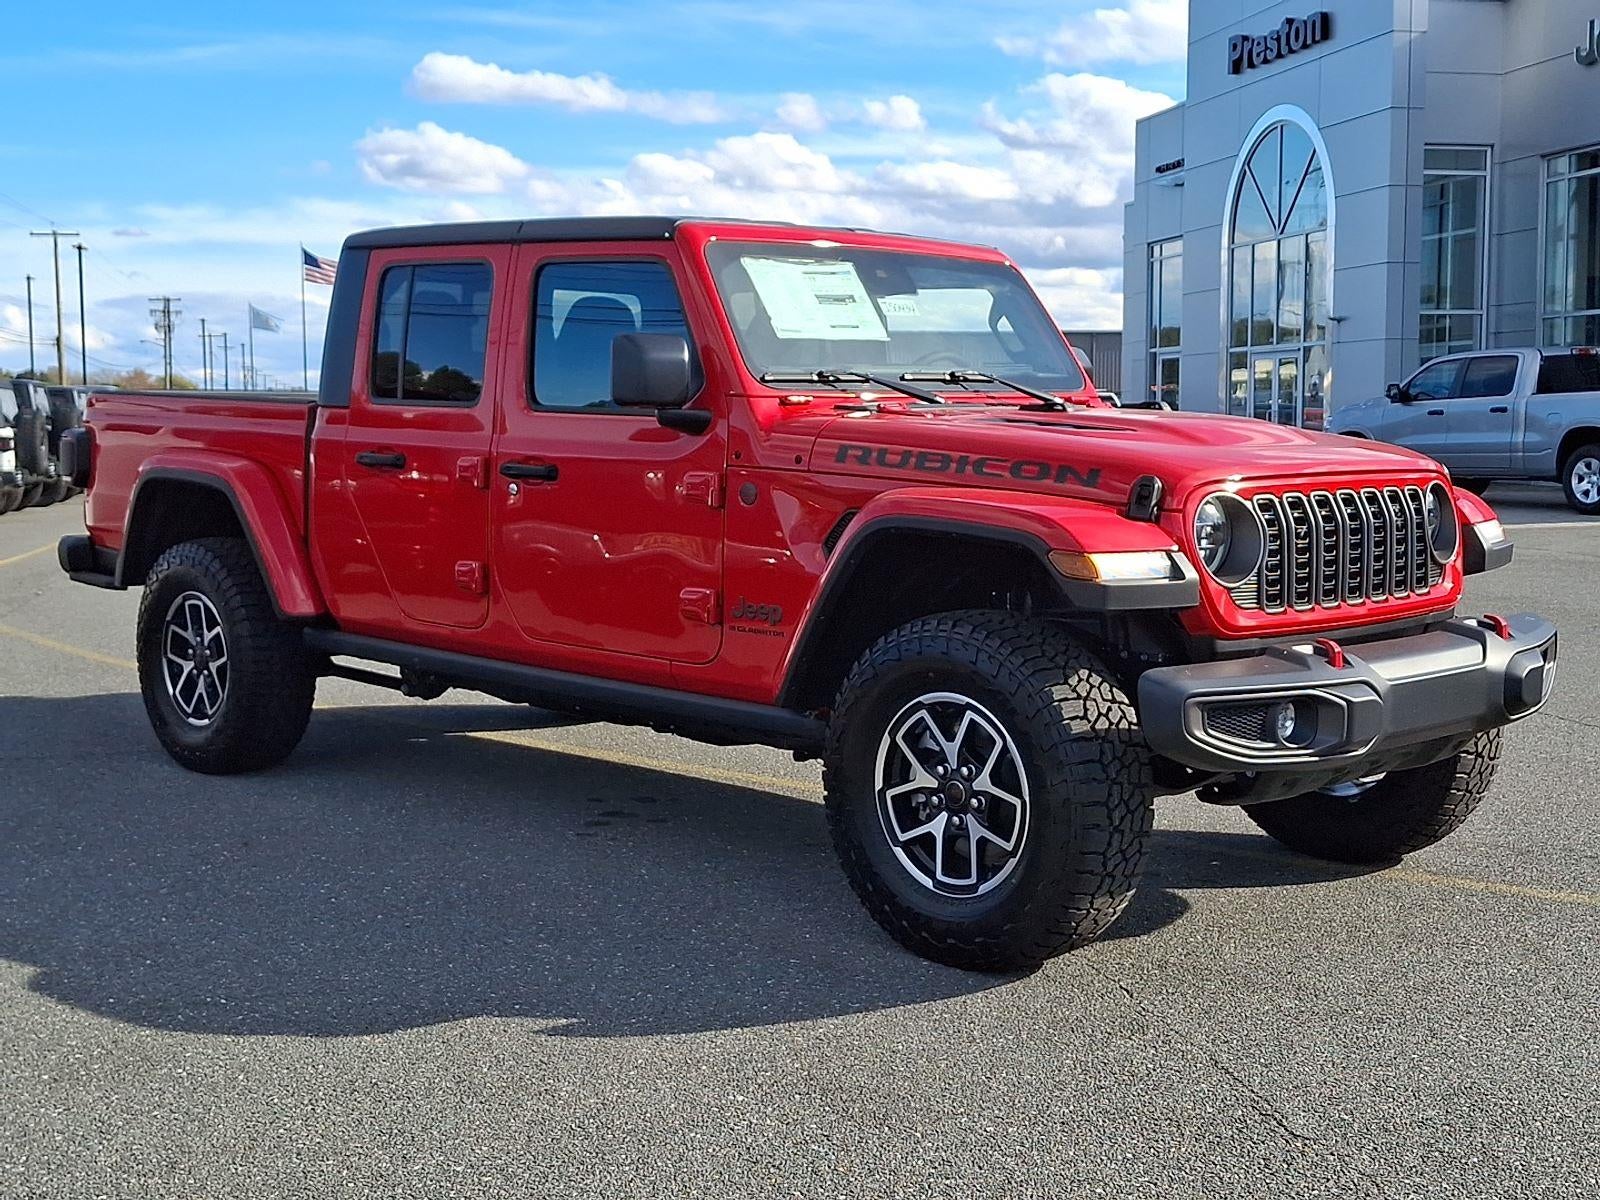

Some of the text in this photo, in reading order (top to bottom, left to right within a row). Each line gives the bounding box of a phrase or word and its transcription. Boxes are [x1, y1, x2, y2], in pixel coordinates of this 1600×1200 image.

[1228, 11, 1330, 75] Preston
[834, 443, 1102, 488] RUBICON
[732, 596, 783, 627] Jeep
